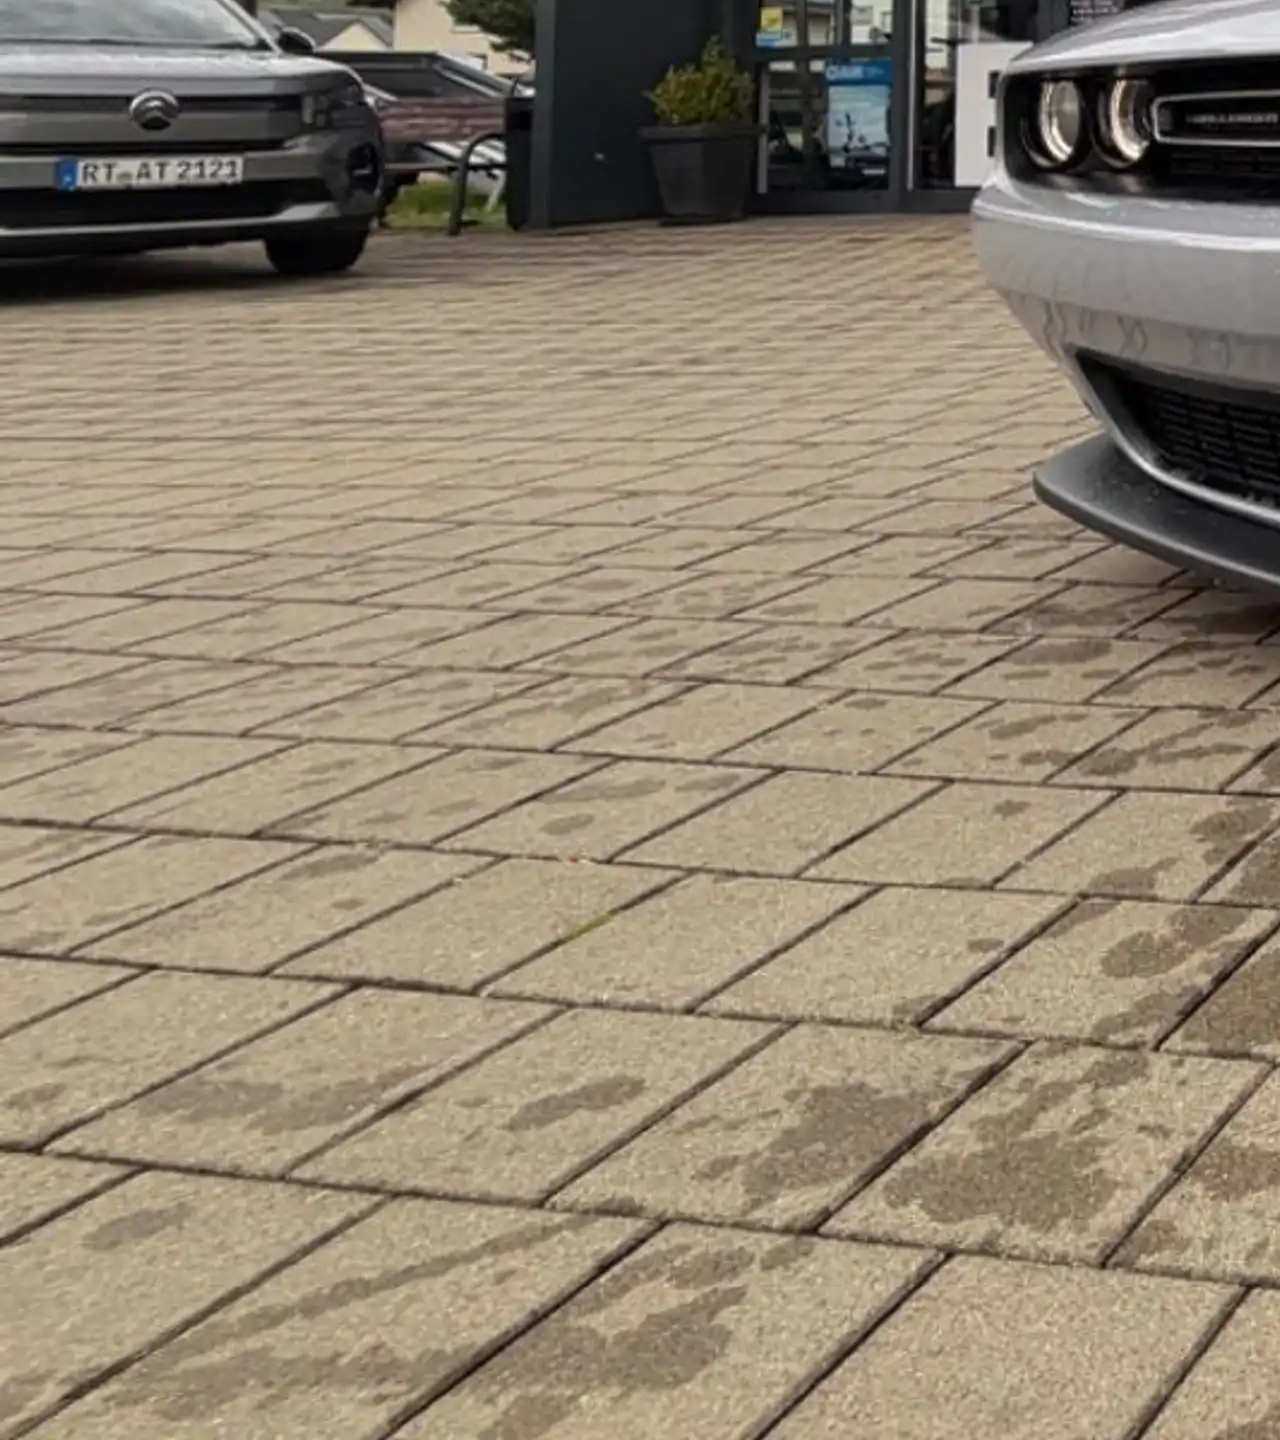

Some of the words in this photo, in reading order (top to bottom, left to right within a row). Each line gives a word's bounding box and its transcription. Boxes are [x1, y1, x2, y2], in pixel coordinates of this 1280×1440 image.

[82, 162, 117, 183] RT
[136, 162, 168, 180] AT
[177, 160, 237, 179] 2121
